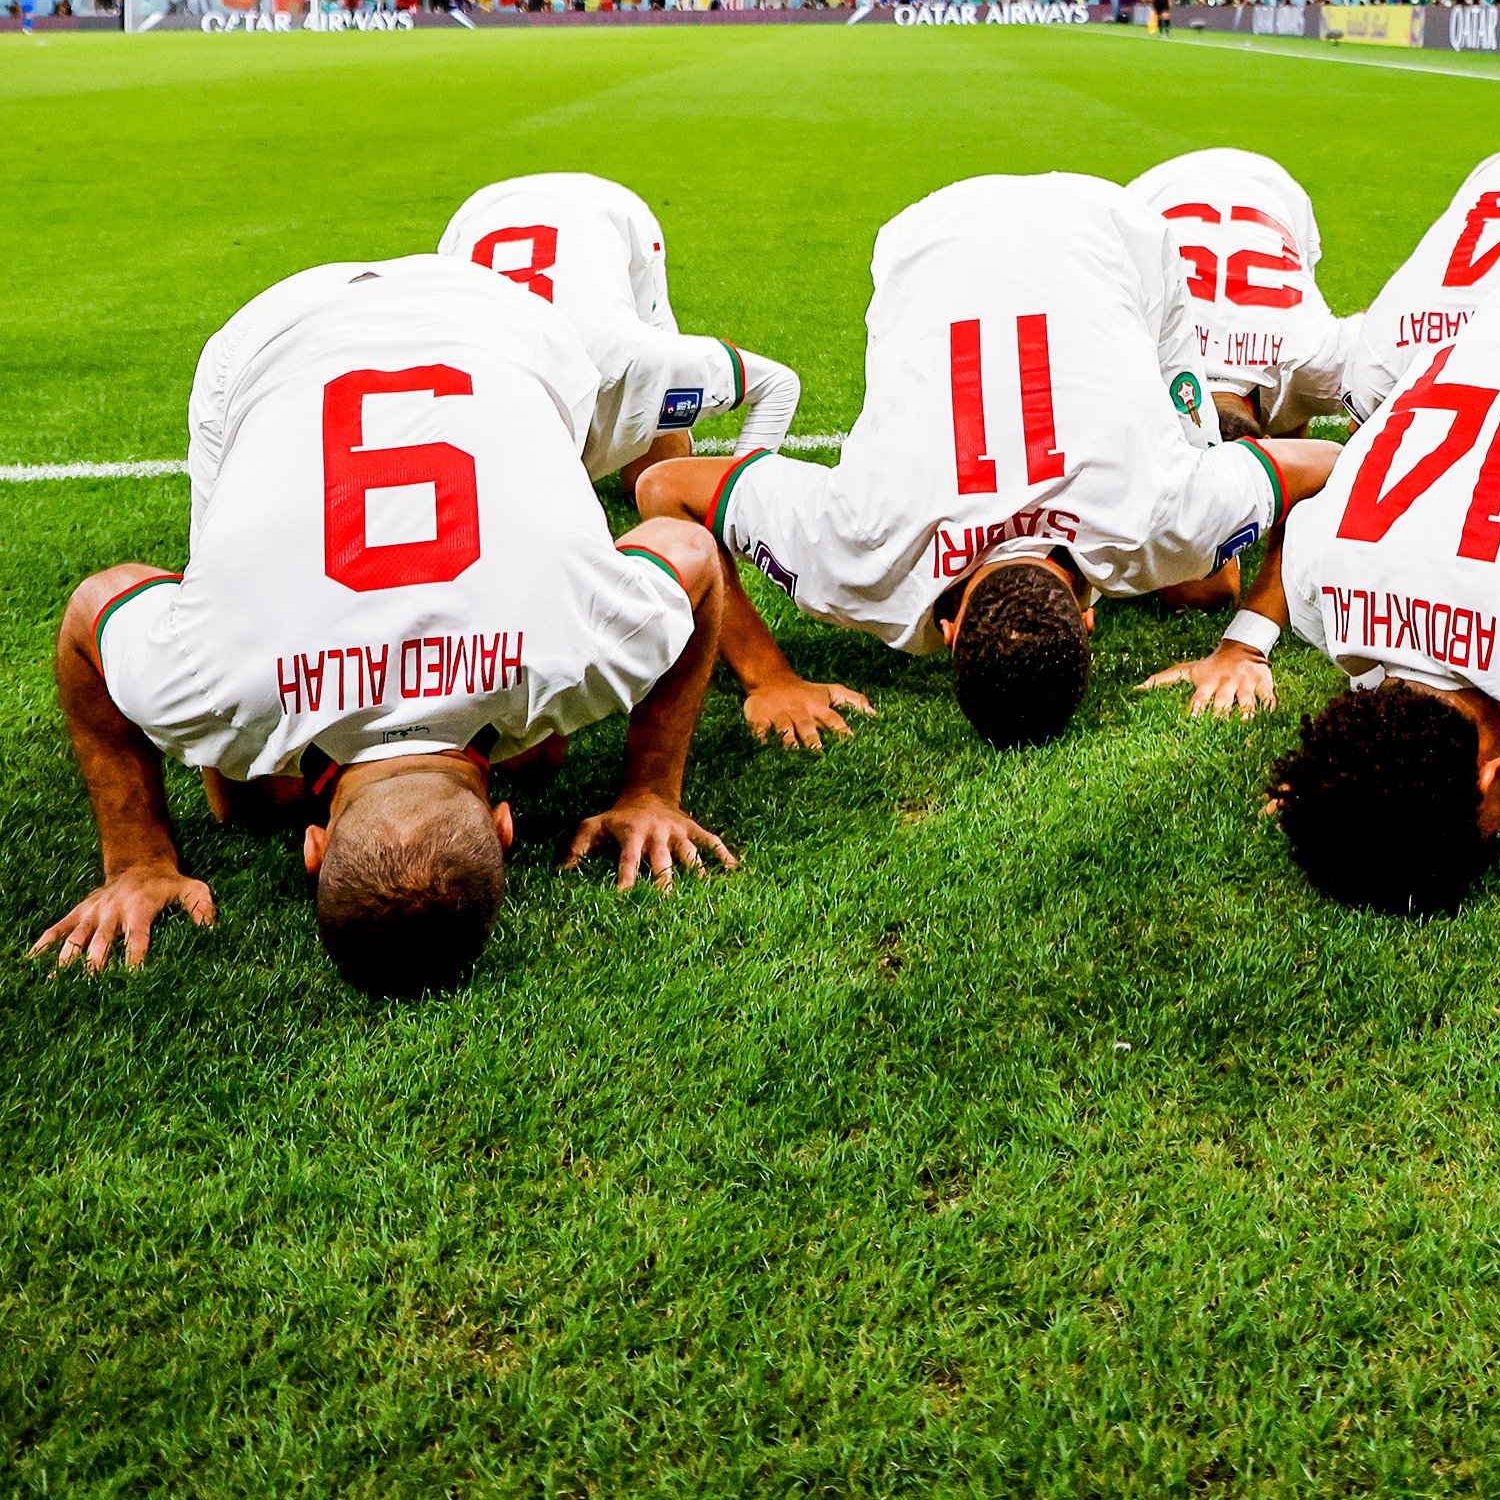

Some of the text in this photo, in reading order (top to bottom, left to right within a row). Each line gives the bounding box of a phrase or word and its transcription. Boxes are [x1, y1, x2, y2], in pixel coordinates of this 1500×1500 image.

[893, 3, 1091, 26] QATAR AIRWAYS
[1449, 6, 1499, 52] QATAR
[950, 313, 1065, 496] 11
[322, 363, 481, 594] 9
[276, 631, 524, 716] HAMED ALLAH
